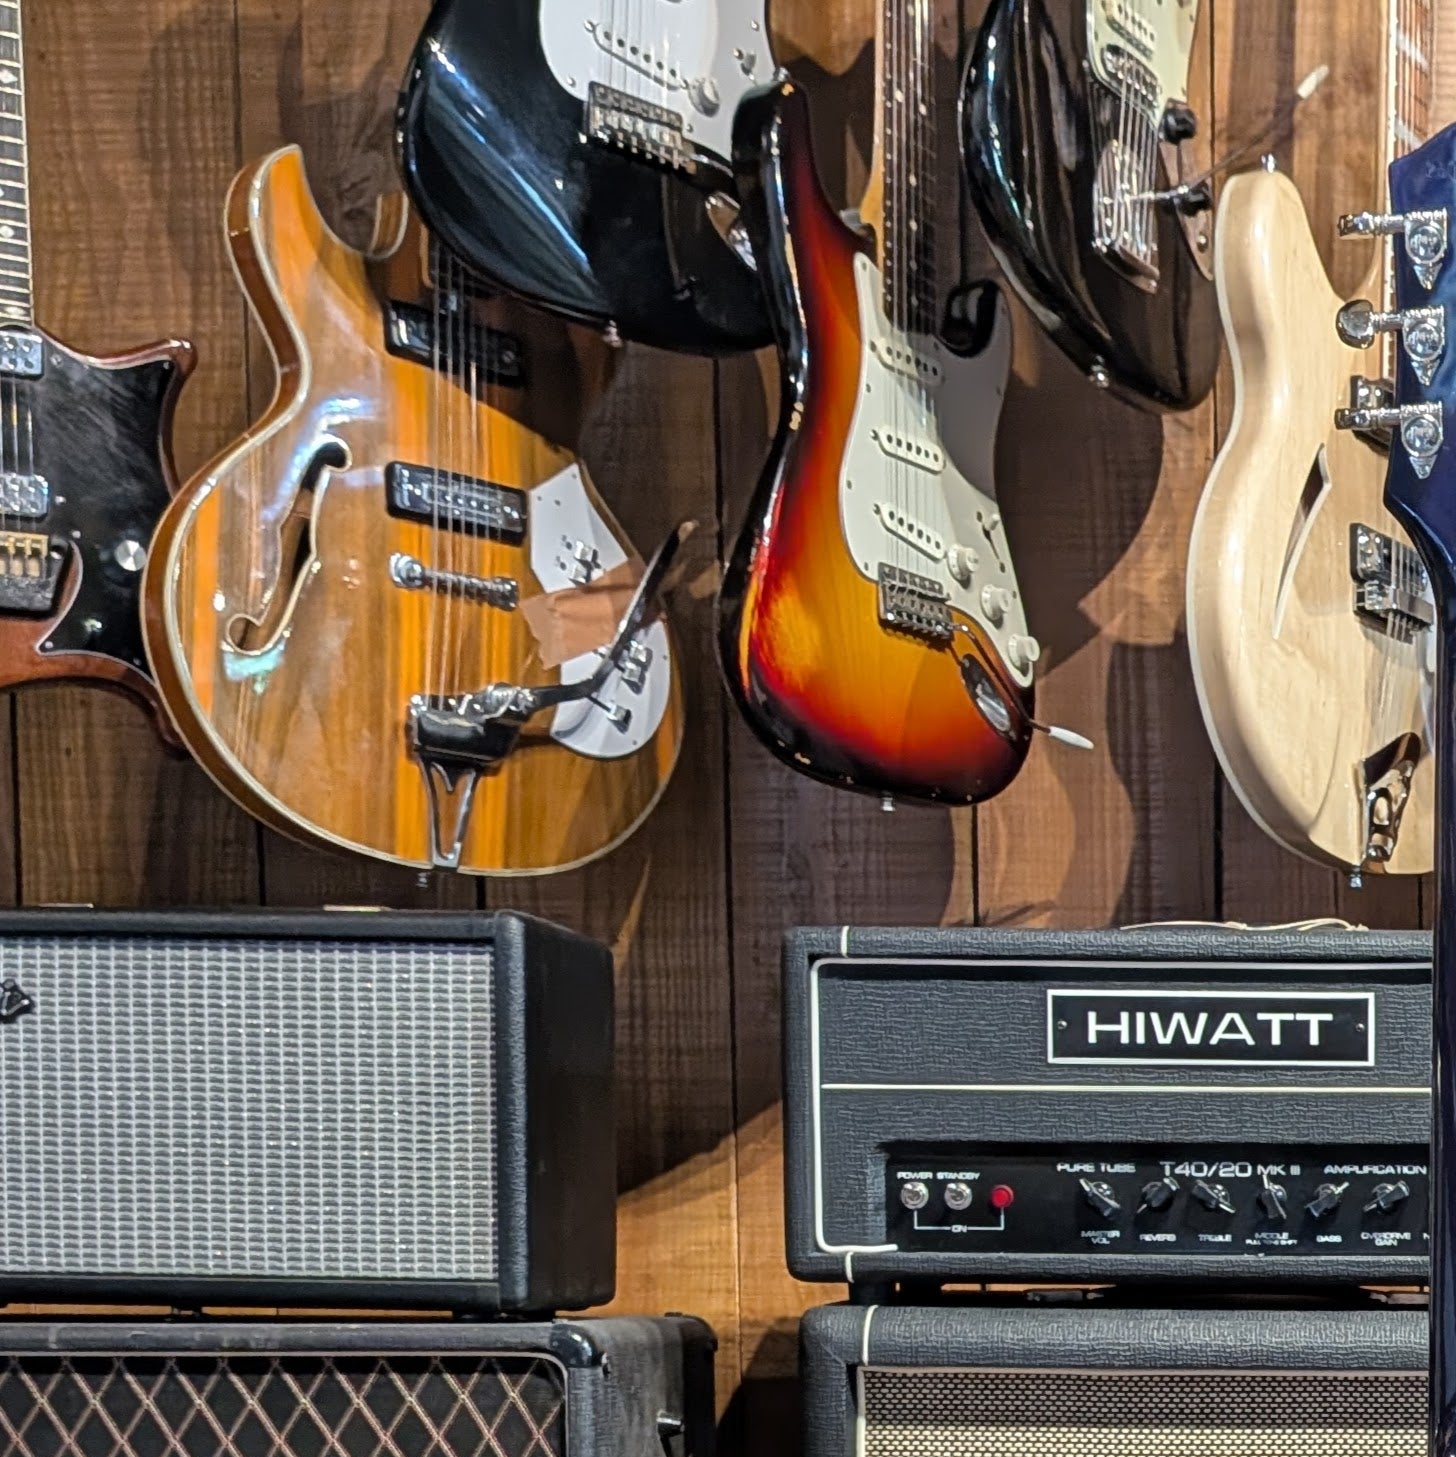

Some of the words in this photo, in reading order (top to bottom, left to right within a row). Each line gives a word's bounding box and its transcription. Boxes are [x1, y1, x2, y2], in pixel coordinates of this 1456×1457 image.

[1087, 1010, 1334, 1046] HIWATT
[1056, 1162, 1096, 1173] PURE
[1099, 1162, 1136, 1173] TUBE
[1159, 1160, 1252, 1178] T40/20
[1257, 1163, 1287, 1176] MK
[1323, 1163, 1427, 1176] AMPLIFICATION
[896, 1171, 934, 1180] POWER
[936, 1171, 981, 1180] STANDBY
[951, 1224, 967, 1233] ON
[1080, 1229, 1121, 1238] MASTER
[1139, 1233, 1177, 1242] REVERB
[1198, 1233, 1233, 1242] TREBLE
[1090, 1237, 1111, 1245] VOL
[1316, 1234, 1342, 1243] BASS
